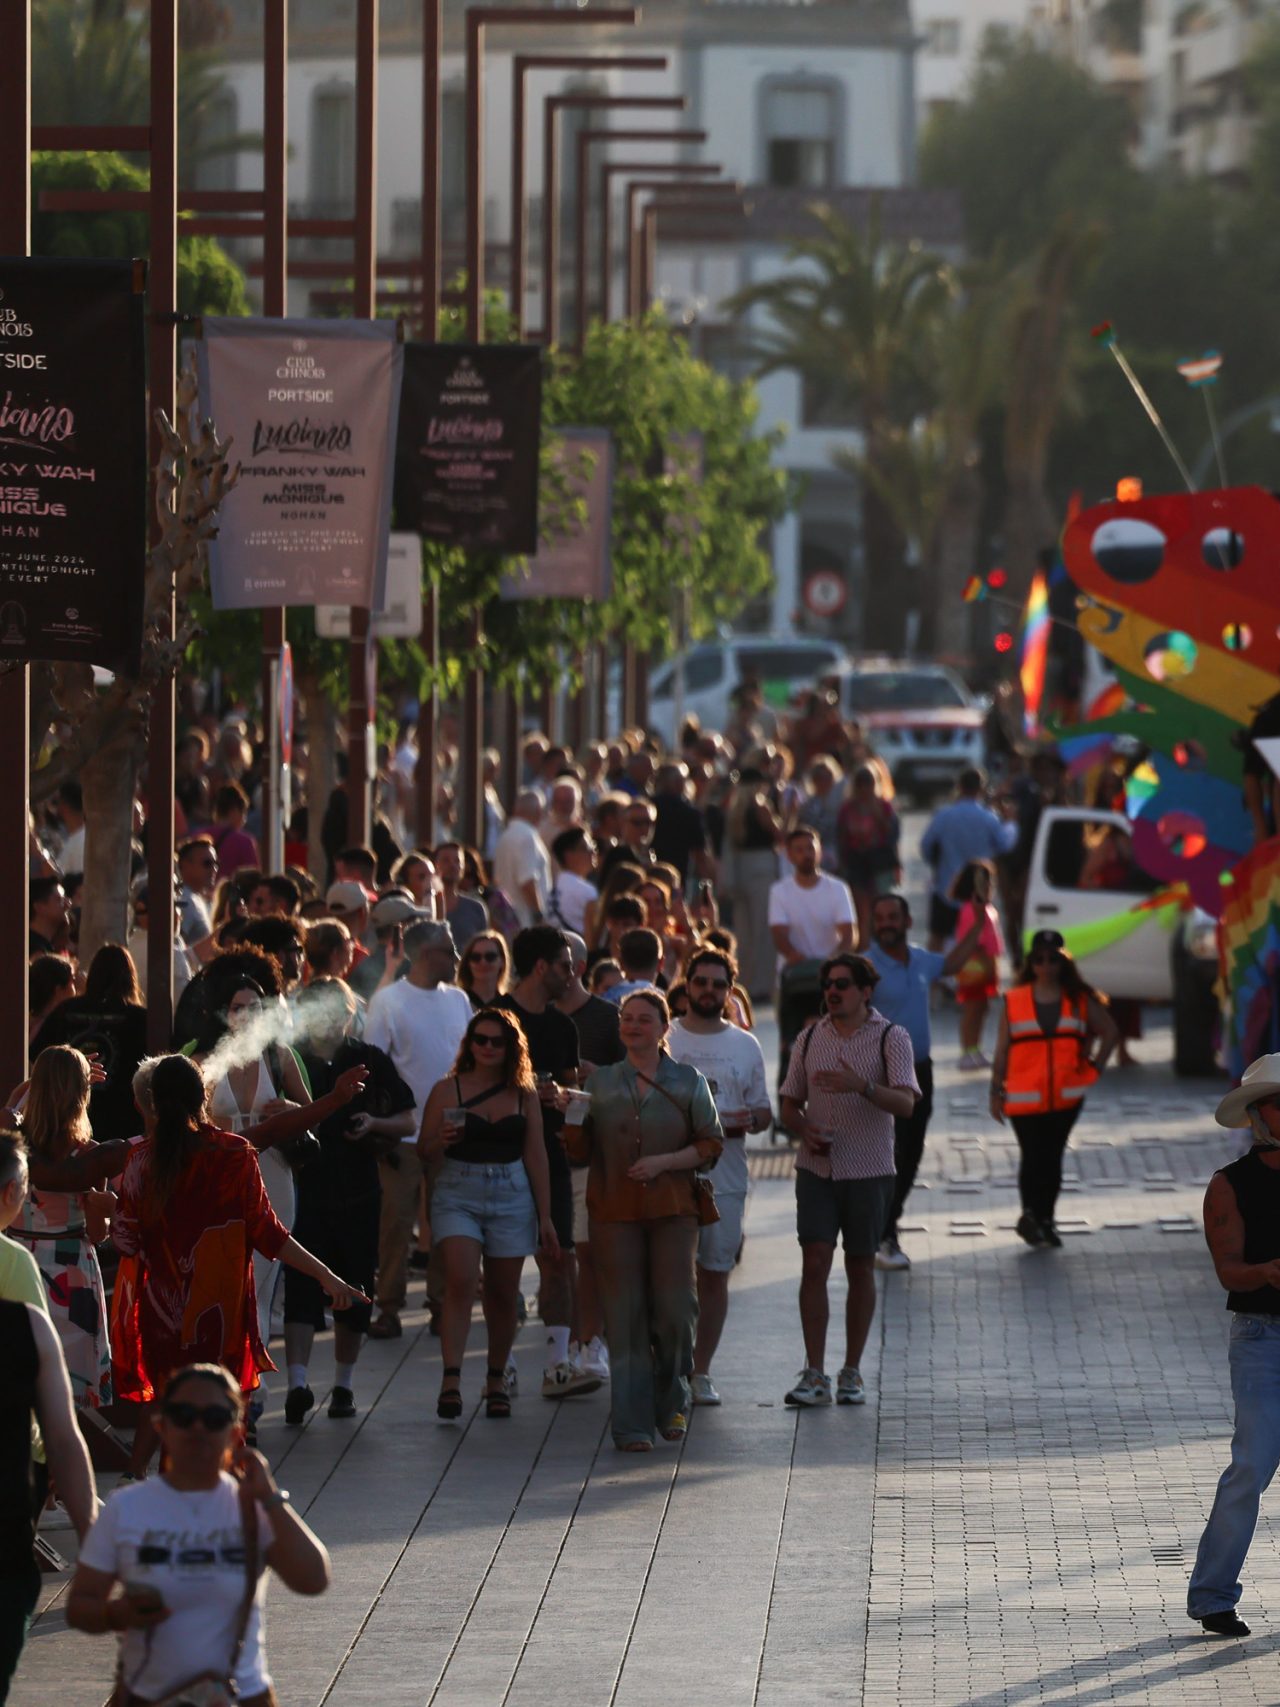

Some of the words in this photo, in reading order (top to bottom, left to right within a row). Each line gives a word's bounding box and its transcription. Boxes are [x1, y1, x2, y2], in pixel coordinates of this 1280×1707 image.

[268, 389, 334, 402] PORTSIDE
[35, 463, 96, 482] WAH
[322, 466, 366, 477] WAH
[281, 482, 327, 494] MISS
[262, 493, 345, 505] MONIQUE
[17, 553, 47, 562] JUNE
[36, 565, 97, 577] MIDNIGHT
[9, 574, 49, 583] EVENT
